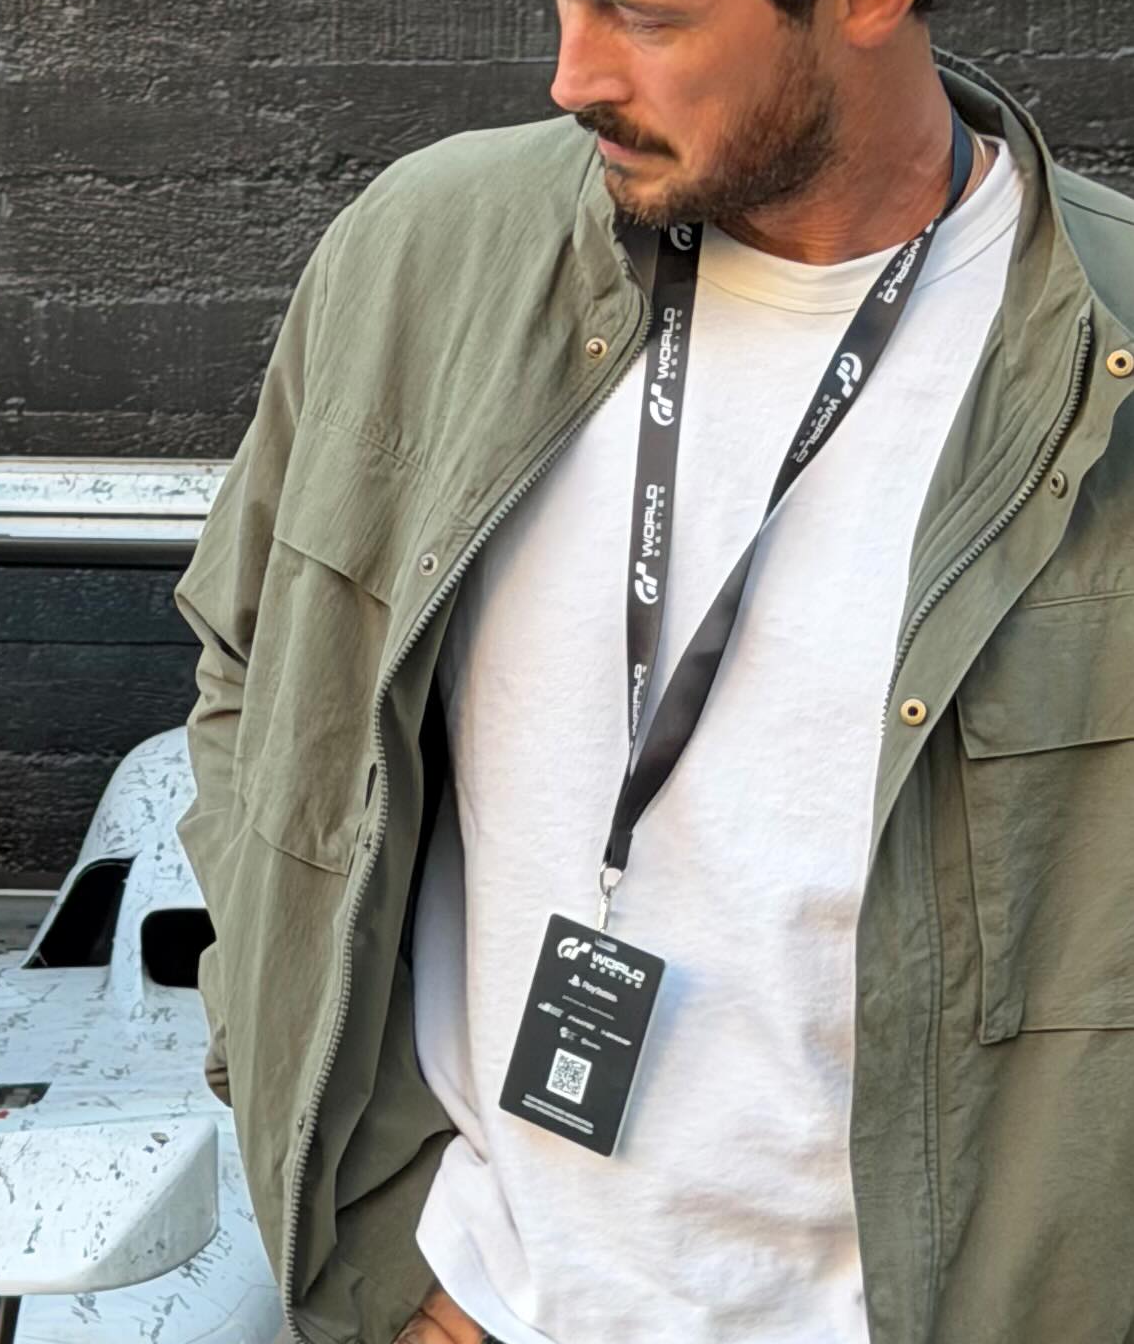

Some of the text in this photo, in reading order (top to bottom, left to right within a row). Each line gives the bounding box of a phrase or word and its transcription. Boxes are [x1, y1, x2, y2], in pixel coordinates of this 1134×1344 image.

[656, 306, 676, 381] WORLD
[640, 482, 659, 558] WORLD
[591, 951, 646, 982] WORLD
